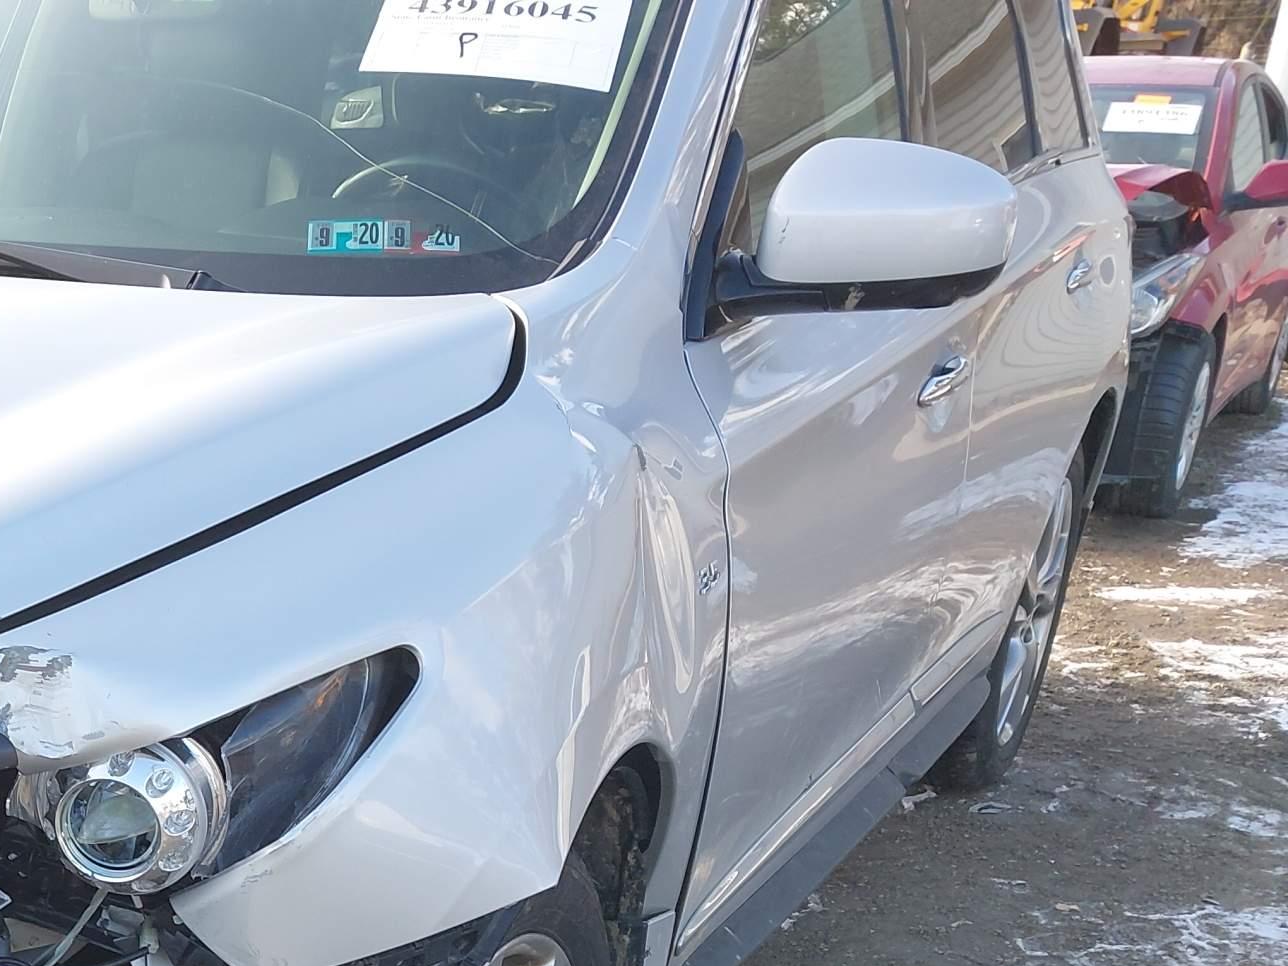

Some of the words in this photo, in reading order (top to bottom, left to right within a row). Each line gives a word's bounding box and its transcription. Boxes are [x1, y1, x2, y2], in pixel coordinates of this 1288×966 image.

[408, 0, 598, 22] 43916045
[319, 227, 330, 247] 9
[359, 222, 379, 245] 20
[394, 227, 405, 247] 9
